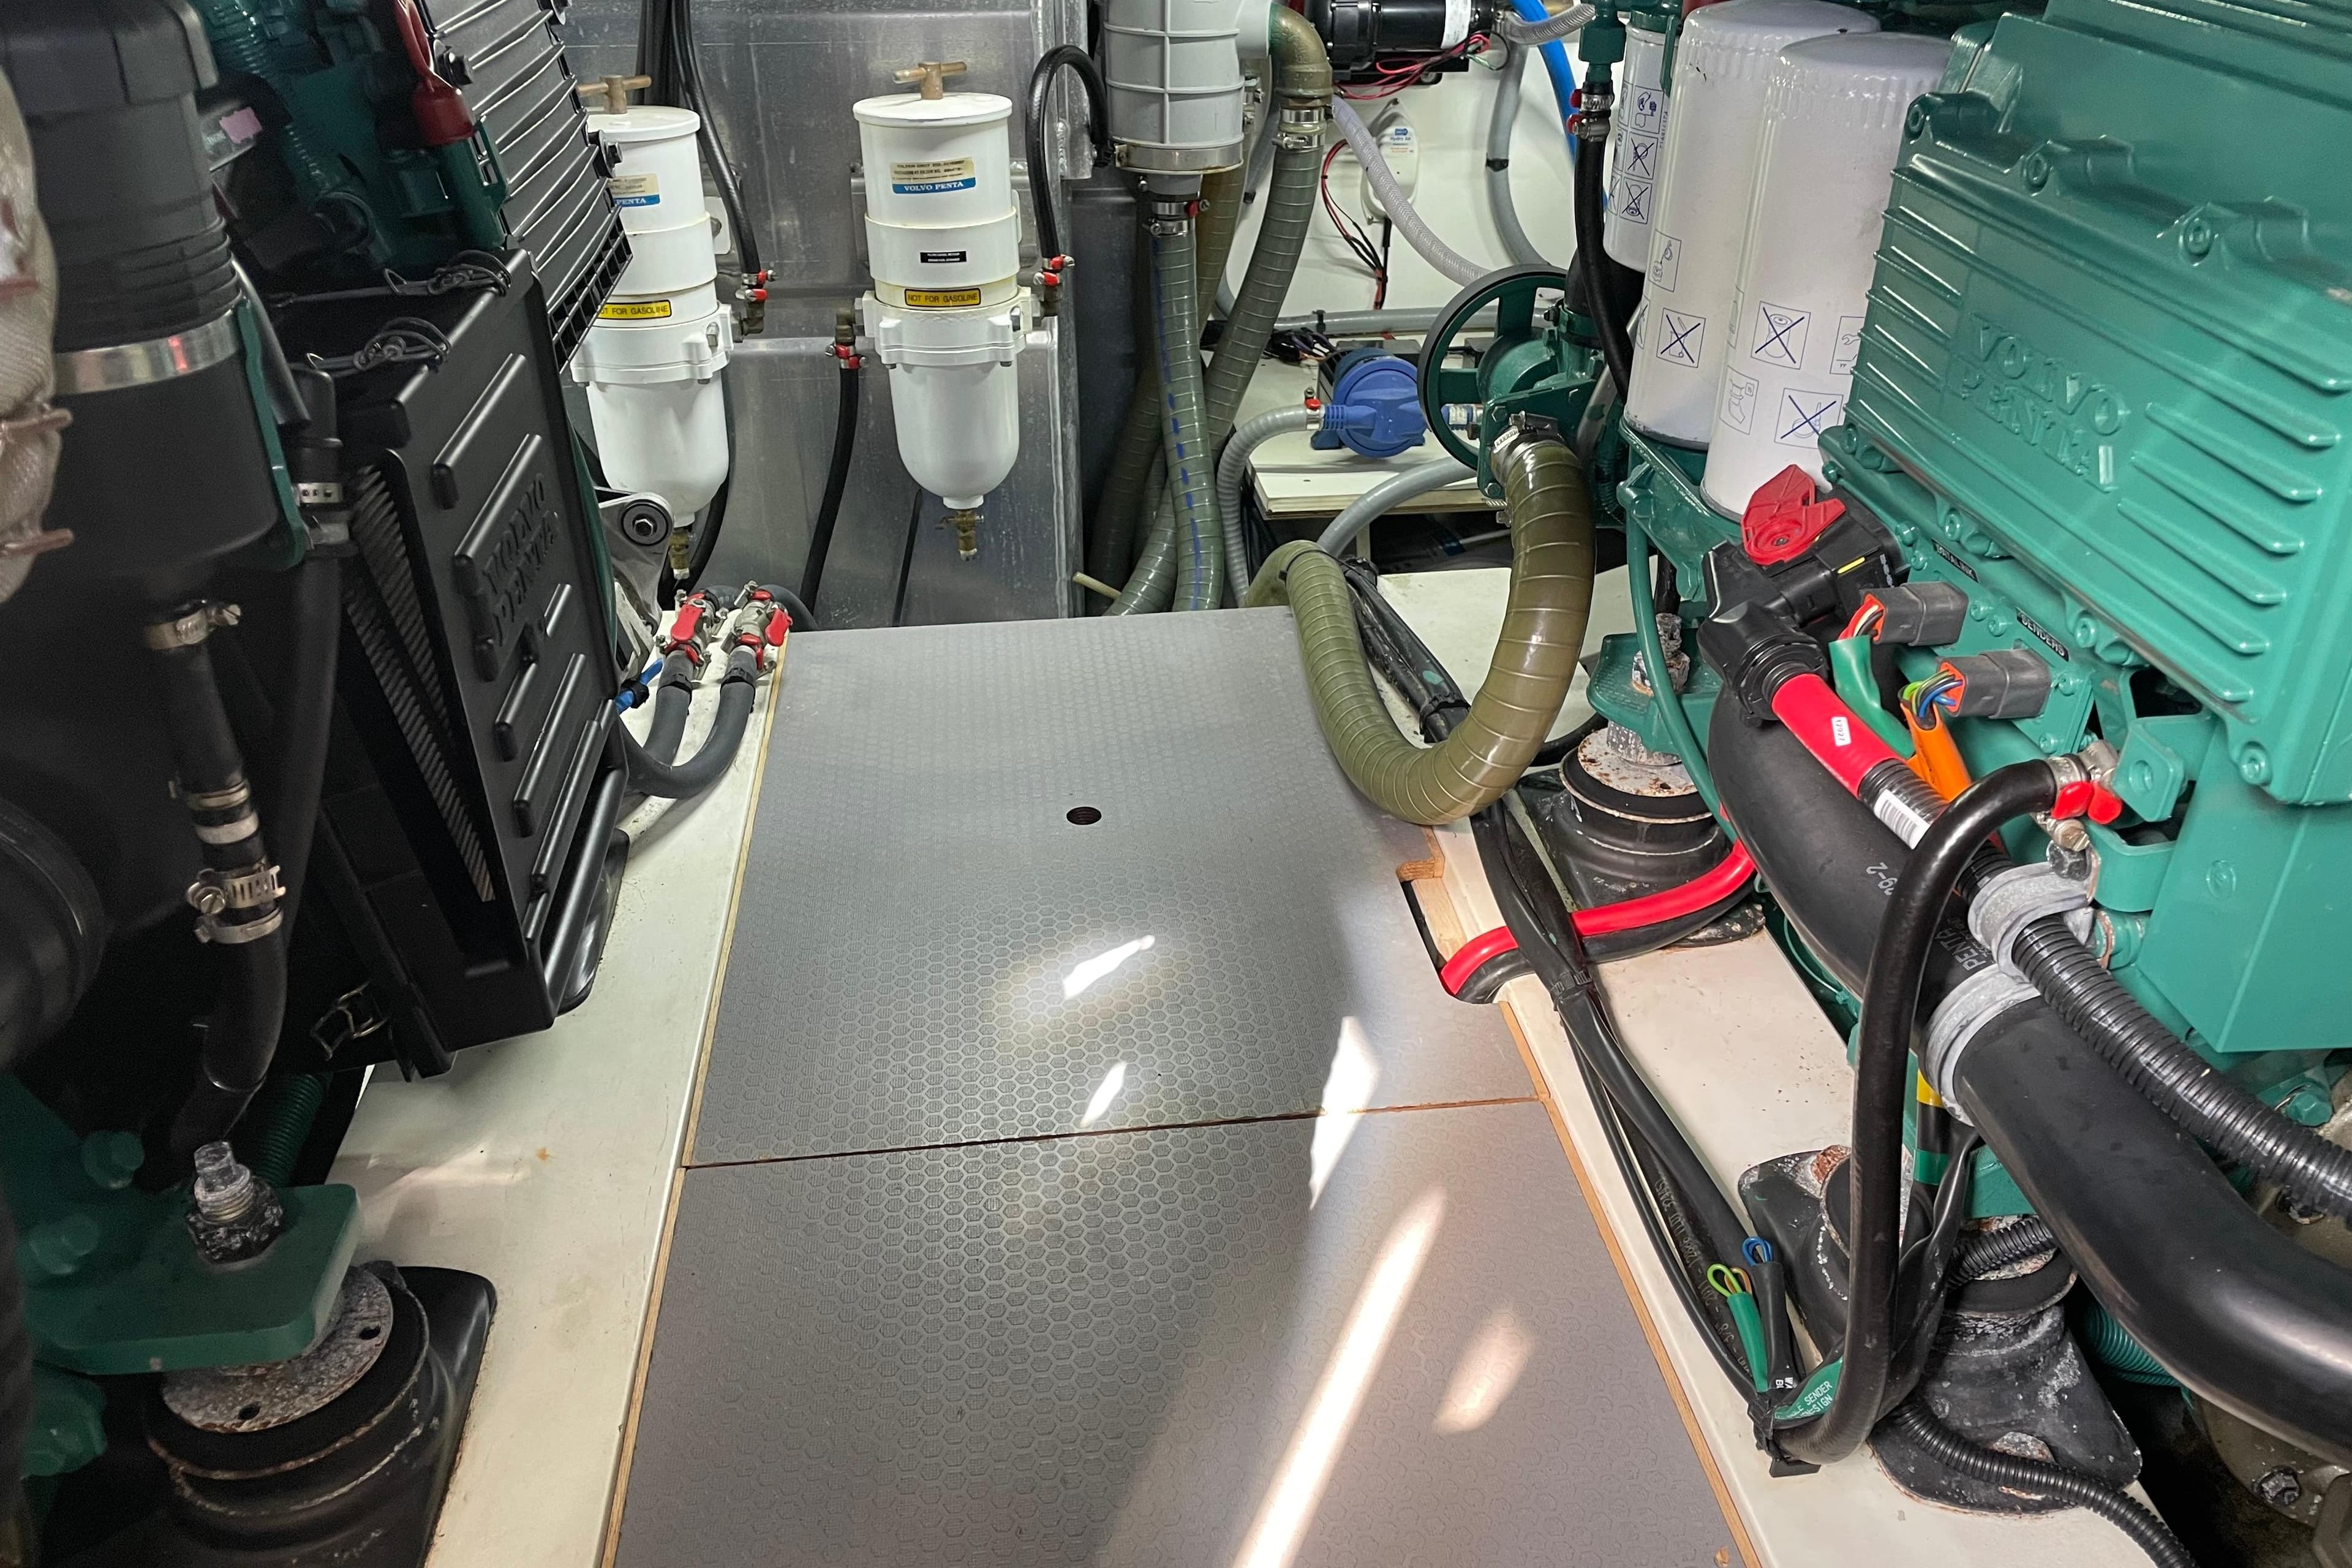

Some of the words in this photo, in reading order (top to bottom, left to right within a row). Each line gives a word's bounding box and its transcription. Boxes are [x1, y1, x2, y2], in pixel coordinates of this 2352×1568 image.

[935, 181, 963, 190] PENTA
[631, 305, 668, 315] GASOLINE
[943, 293, 978, 302] GASOLINE
[1969, 314, 2127, 436] VOLVO
[1954, 352, 2119, 494] PENTA
[2021, 614, 2065, 657] SENDERS
[1935, 928, 1986, 971] PENTA
[1804, 1381, 1833, 1406] SENDER
